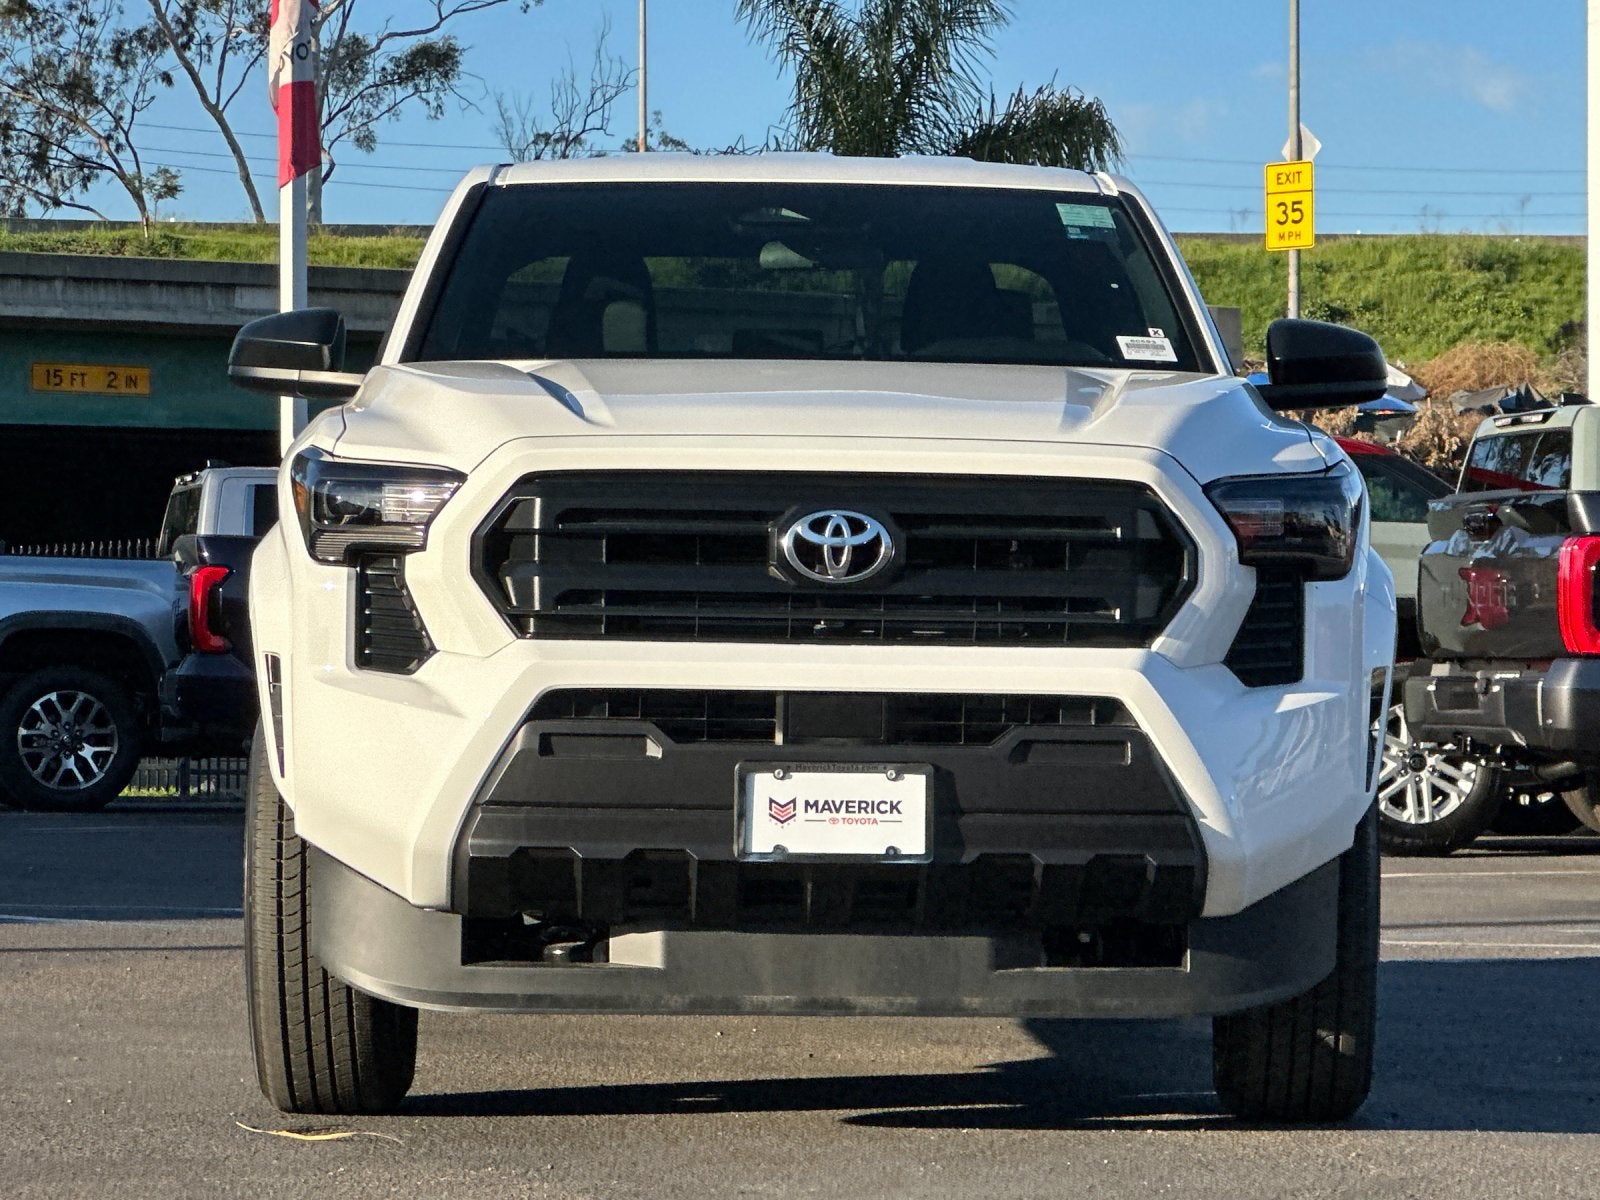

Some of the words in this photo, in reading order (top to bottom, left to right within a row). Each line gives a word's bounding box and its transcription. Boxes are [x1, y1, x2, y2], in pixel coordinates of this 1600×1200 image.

[1276, 171, 1302, 185] EXIT
[1276, 201, 1304, 226] 35
[1278, 230, 1302, 241] MPH
[44, 368, 63, 386] 15
[70, 372, 87, 387] FT
[107, 371, 118, 389] 2
[125, 375, 138, 389] IN
[804, 799, 903, 815] MAVERICK
[842, 817, 879, 825] TOYOTA
